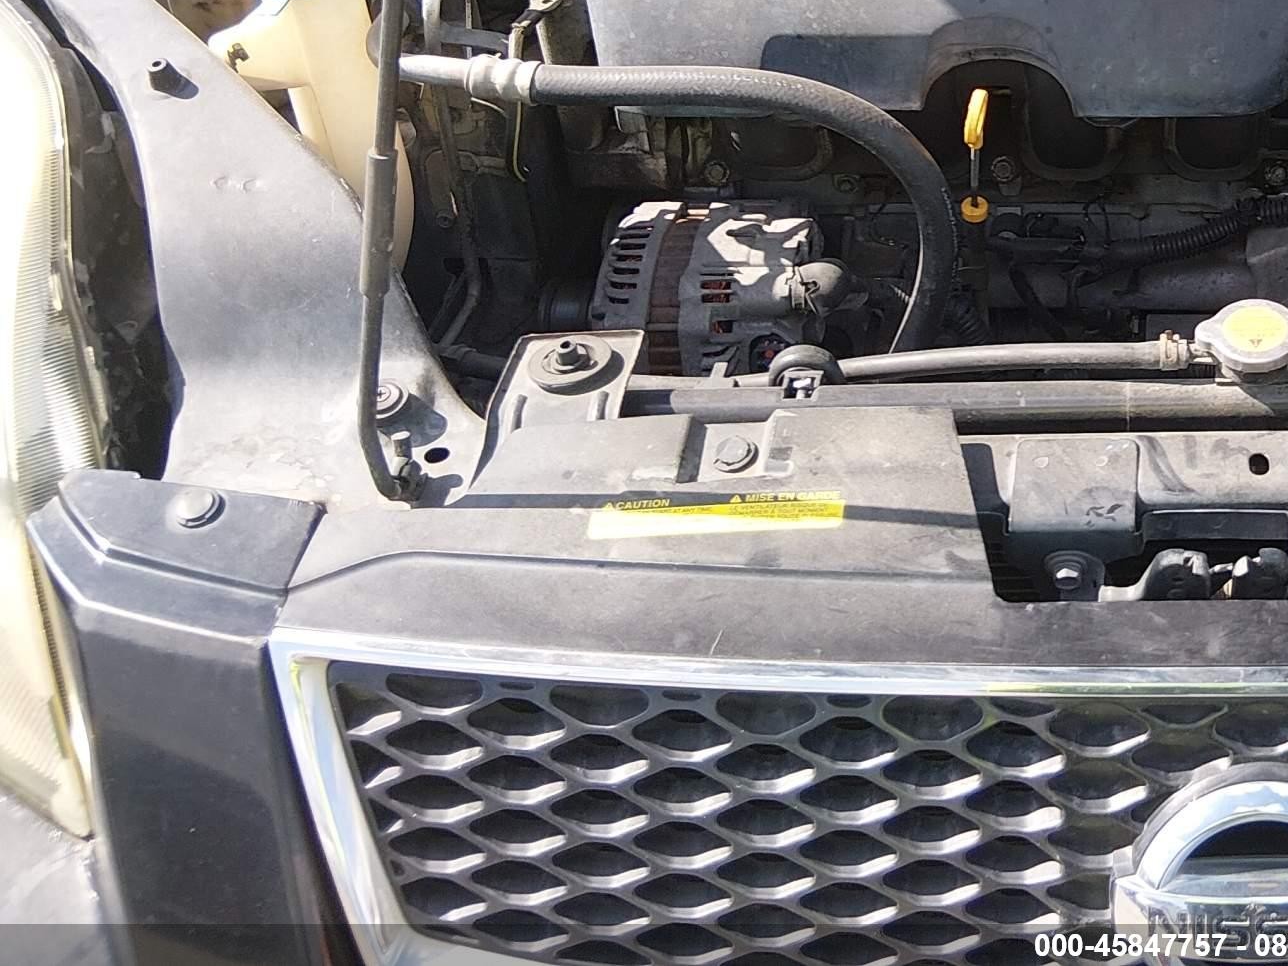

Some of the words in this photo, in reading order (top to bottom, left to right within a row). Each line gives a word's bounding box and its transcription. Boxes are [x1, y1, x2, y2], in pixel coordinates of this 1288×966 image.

[745, 493, 775, 502] MISE
[778, 492, 796, 501] EN
[797, 490, 841, 500] GARDE
[615, 498, 671, 510] CAUTION
